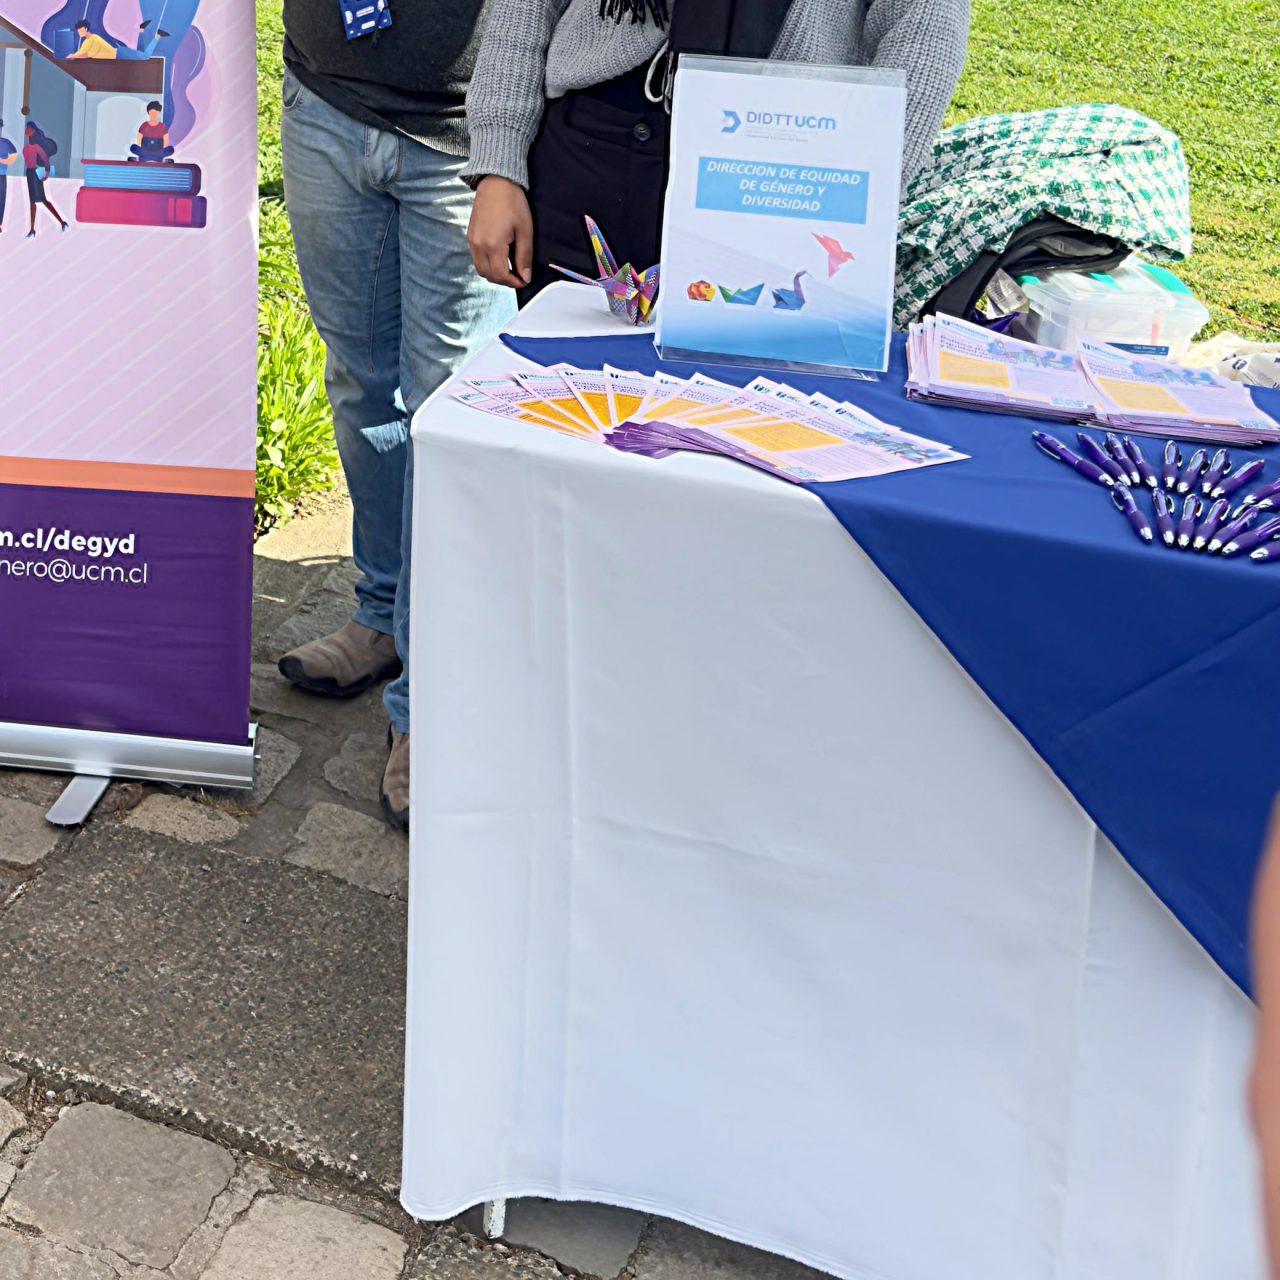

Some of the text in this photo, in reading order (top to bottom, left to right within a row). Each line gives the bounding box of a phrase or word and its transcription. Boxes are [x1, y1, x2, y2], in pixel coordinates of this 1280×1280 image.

[707, 161, 861, 185] DIRECCION DE EQUIDAD
[739, 179, 826, 197] DE GÉNERO Y
[742, 194, 820, 212] DIVERSIDAD
